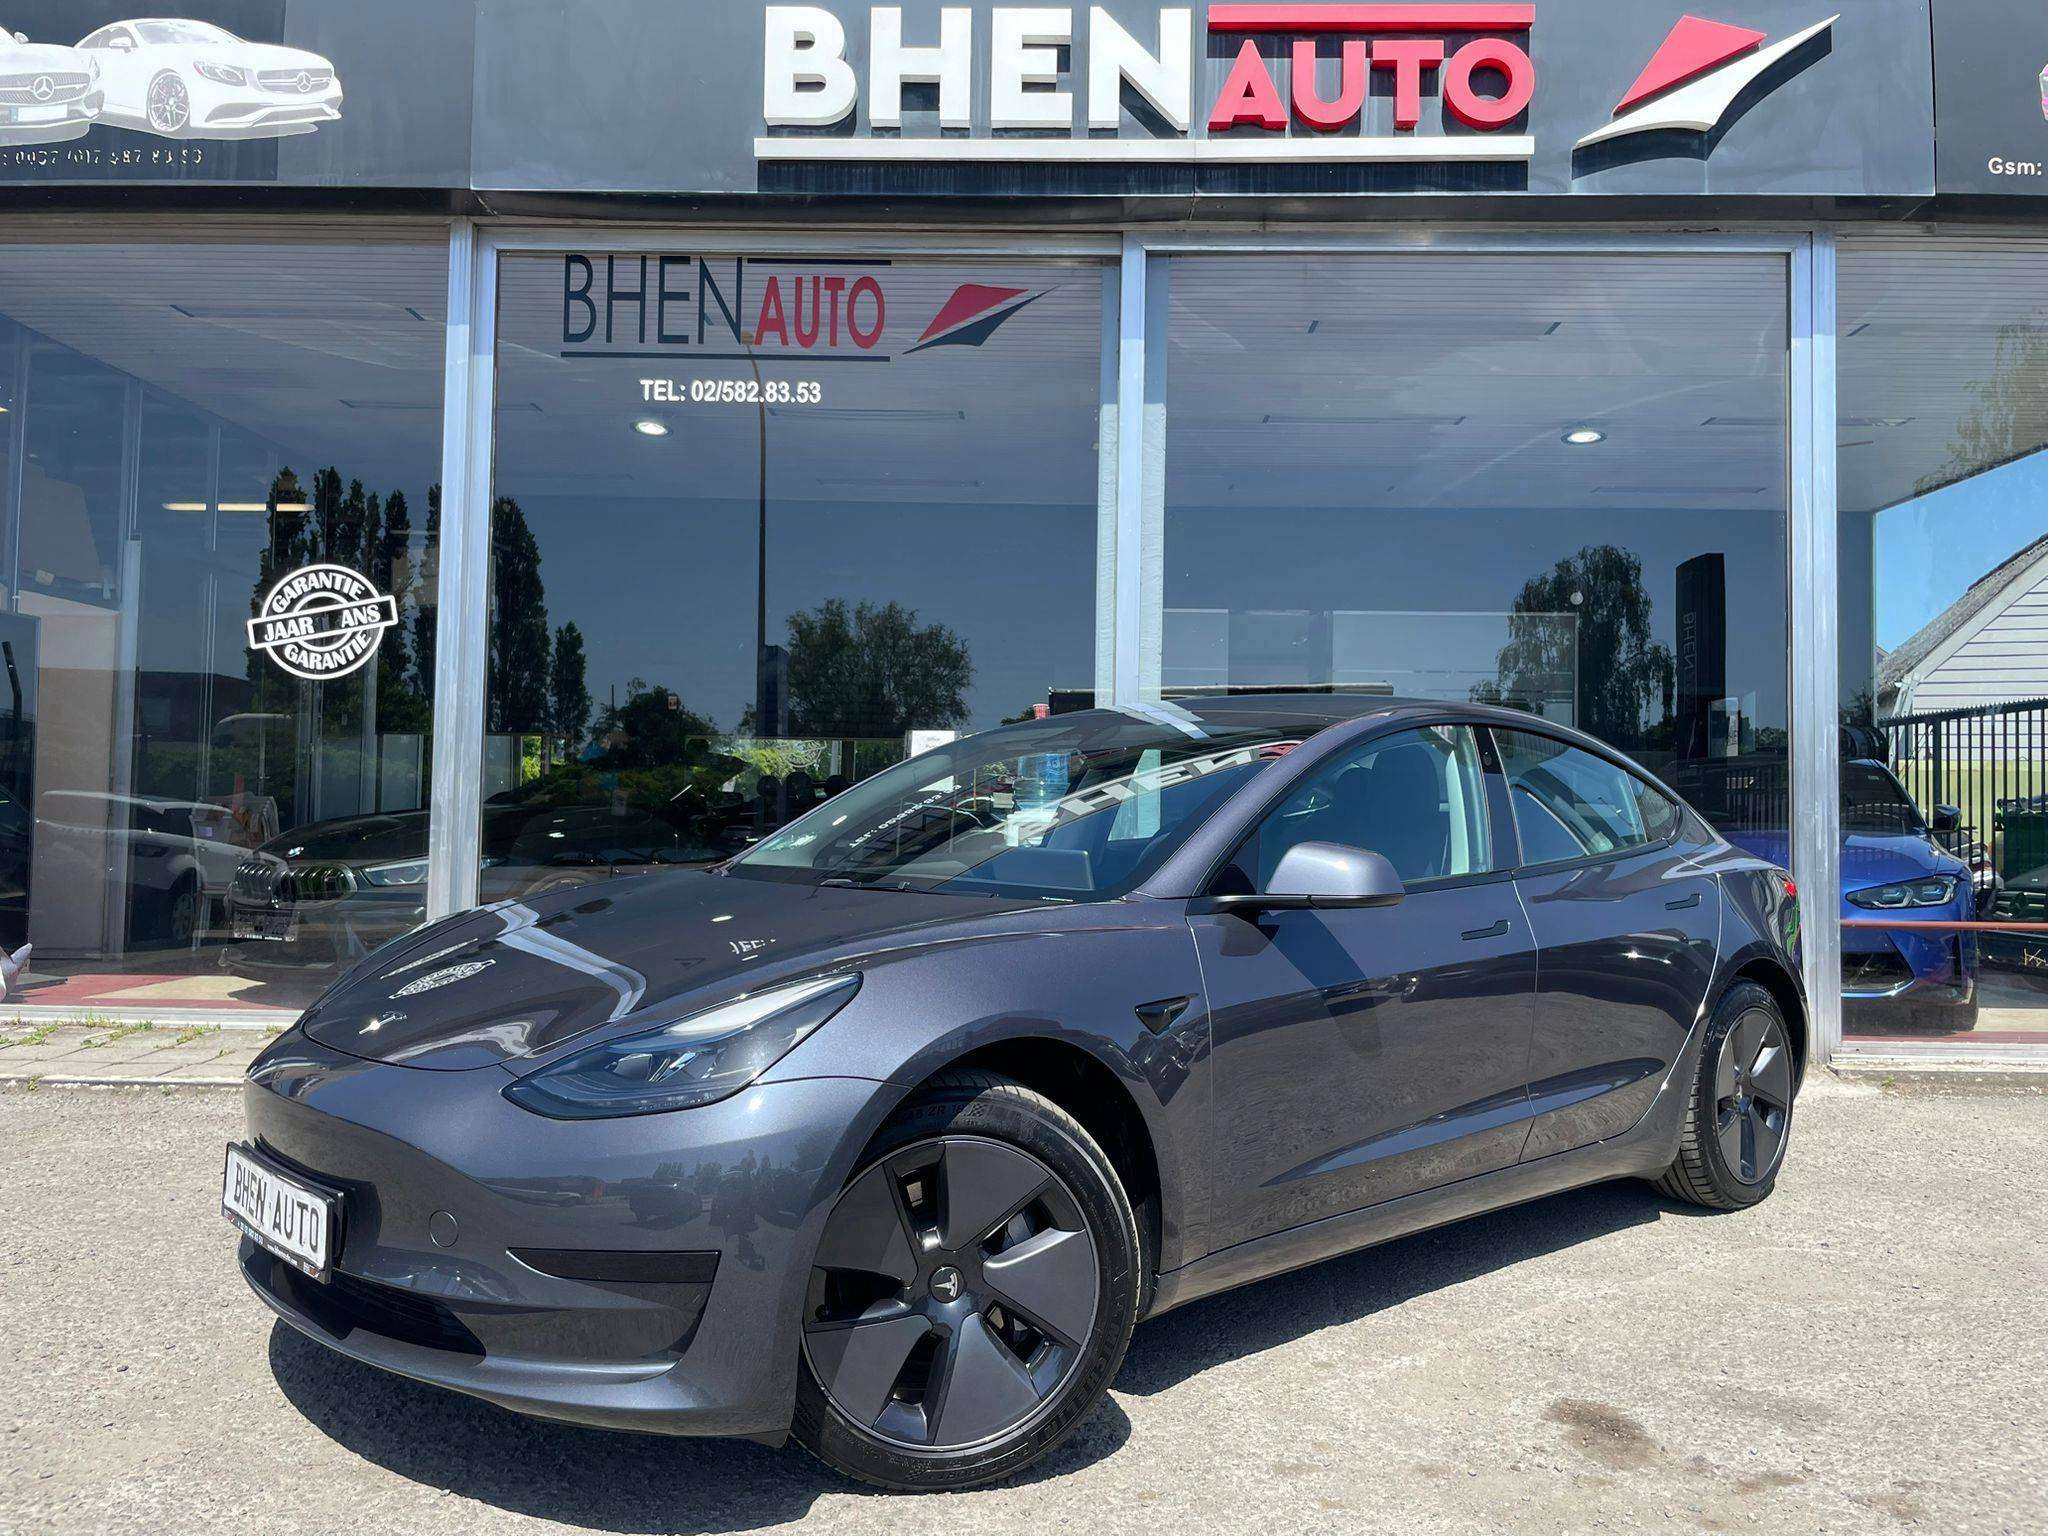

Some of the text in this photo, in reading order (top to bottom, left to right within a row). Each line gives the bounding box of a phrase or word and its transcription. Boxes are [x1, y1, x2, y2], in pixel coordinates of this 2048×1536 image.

[1987, 157, 2042, 176] Gsm:
[639, 379, 821, 403] TEL: 02/582.83.53
[272, 572, 365, 613] GARANTIE
[264, 604, 381, 642] JAAR ANS
[284, 632, 372, 671] GARANTIE
[234, 1162, 320, 1252] BHEN AUTO
